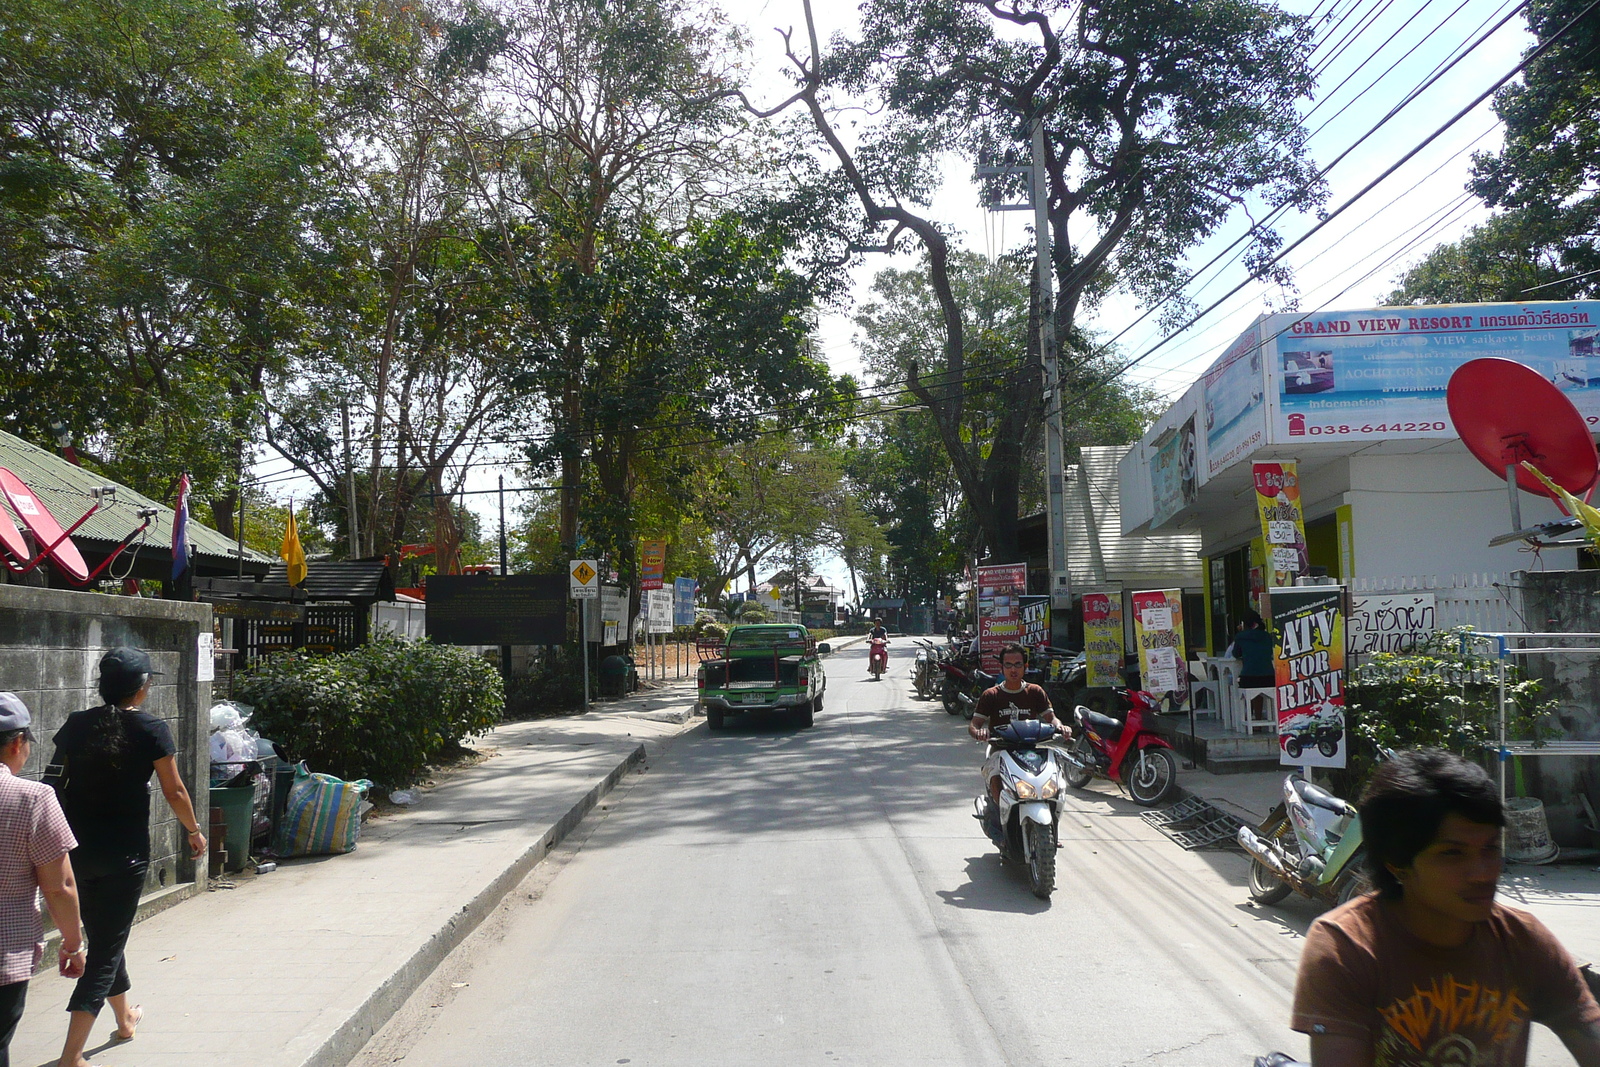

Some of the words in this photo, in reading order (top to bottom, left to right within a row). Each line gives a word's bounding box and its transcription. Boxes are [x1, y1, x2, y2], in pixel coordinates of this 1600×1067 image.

[1292, 320, 1351, 334] GRAND
[1358, 318, 1401, 332] VIEW
[1408, 316, 1472, 330] RESORT
[1434, 335, 1467, 346] VIEW
[1523, 331, 1555, 342] beach
[1396, 366, 1445, 377] GRAND
[1308, 421, 1446, 435] 038-644220
[1265, 471, 1296, 491] Style
[1021, 602, 1048, 625] ATV
[1092, 599, 1121, 613] Style
[1348, 598, 1434, 632] รับซักผ้า
[984, 619, 1018, 628] Special
[1025, 620, 1044, 634] FOR
[1020, 629, 1050, 646] RENT
[1279, 607, 1336, 660] ATV
[1348, 629, 1434, 655] Laundry
[1289, 650, 1329, 681] FOR
[1278, 669, 1342, 711] RENT
